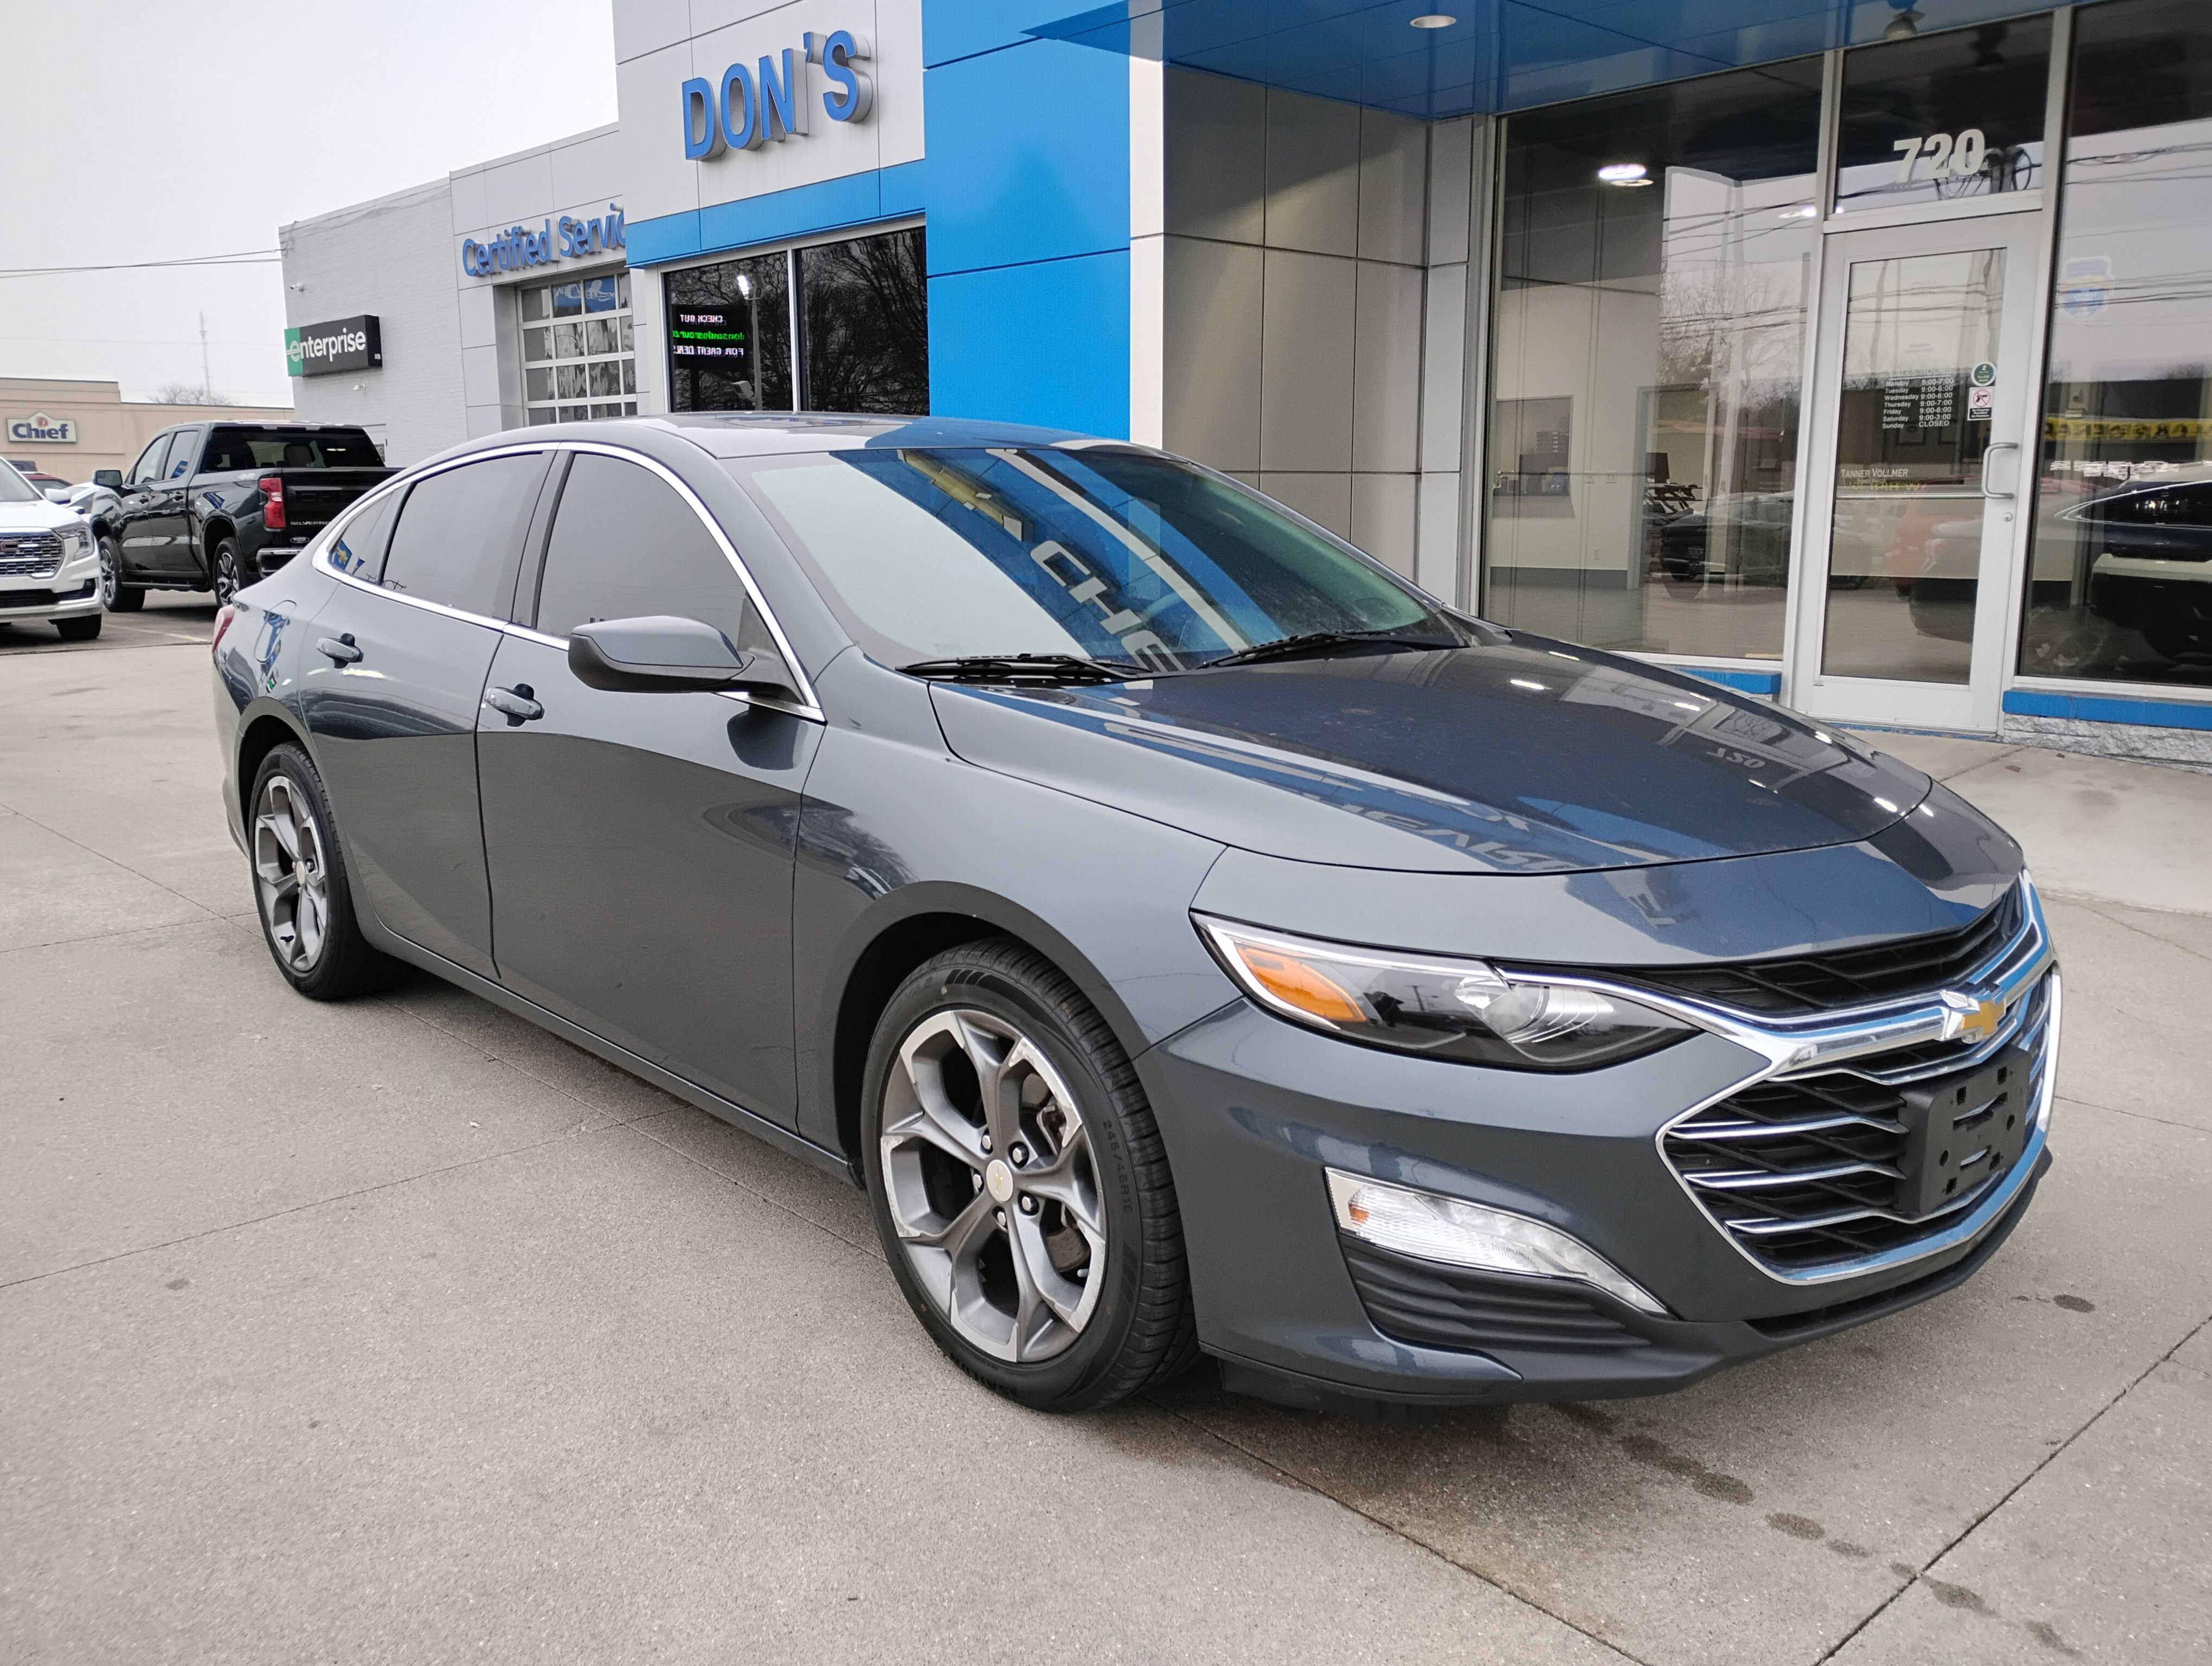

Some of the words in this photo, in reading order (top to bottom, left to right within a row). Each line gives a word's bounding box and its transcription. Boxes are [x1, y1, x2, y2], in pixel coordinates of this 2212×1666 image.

[681, 30, 871, 161] DON'S
[1893, 129, 1985, 183] 720
[462, 219, 557, 277] Certified
[286, 328, 366, 362] enterprise
[12, 423, 68, 439] Chief
[1841, 469, 1870, 477] TANNER
[1872, 468, 1908, 477] VOLLMER
